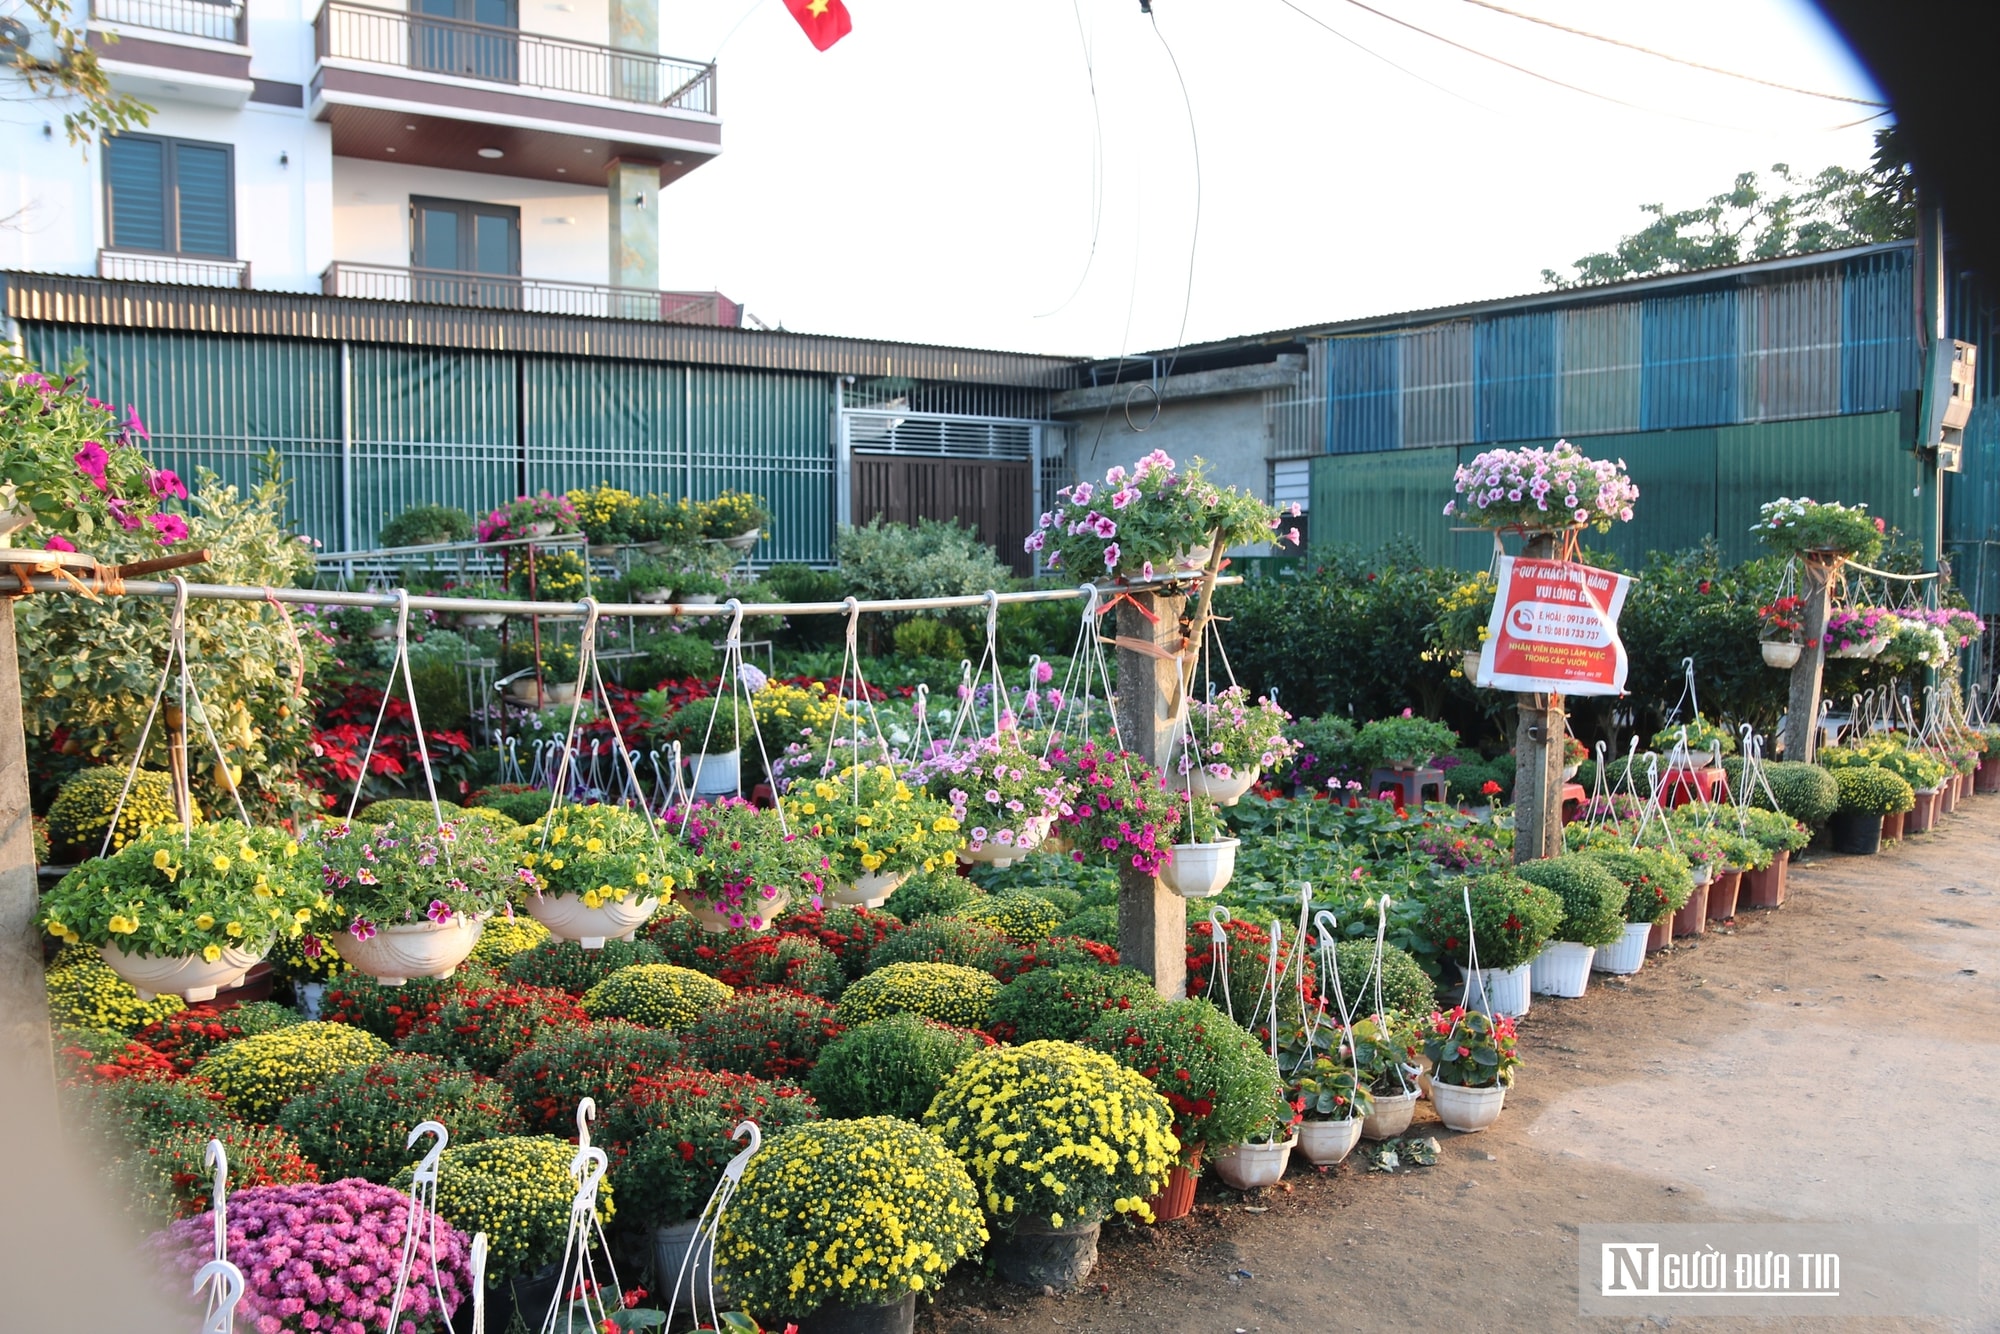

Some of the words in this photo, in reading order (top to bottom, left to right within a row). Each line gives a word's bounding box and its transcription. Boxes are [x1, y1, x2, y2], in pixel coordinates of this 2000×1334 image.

[1519, 565, 1537, 579] QUÝ
[1536, 585, 1551, 597] VUI
[1553, 585, 1576, 602] LÒNG
[1566, 614, 1584, 624] 0913
[1586, 617, 1598, 626] 899
[1572, 629, 1584, 638] 733
[1586, 631, 1600, 640] 737
[1525, 654, 1550, 663] TRONG
